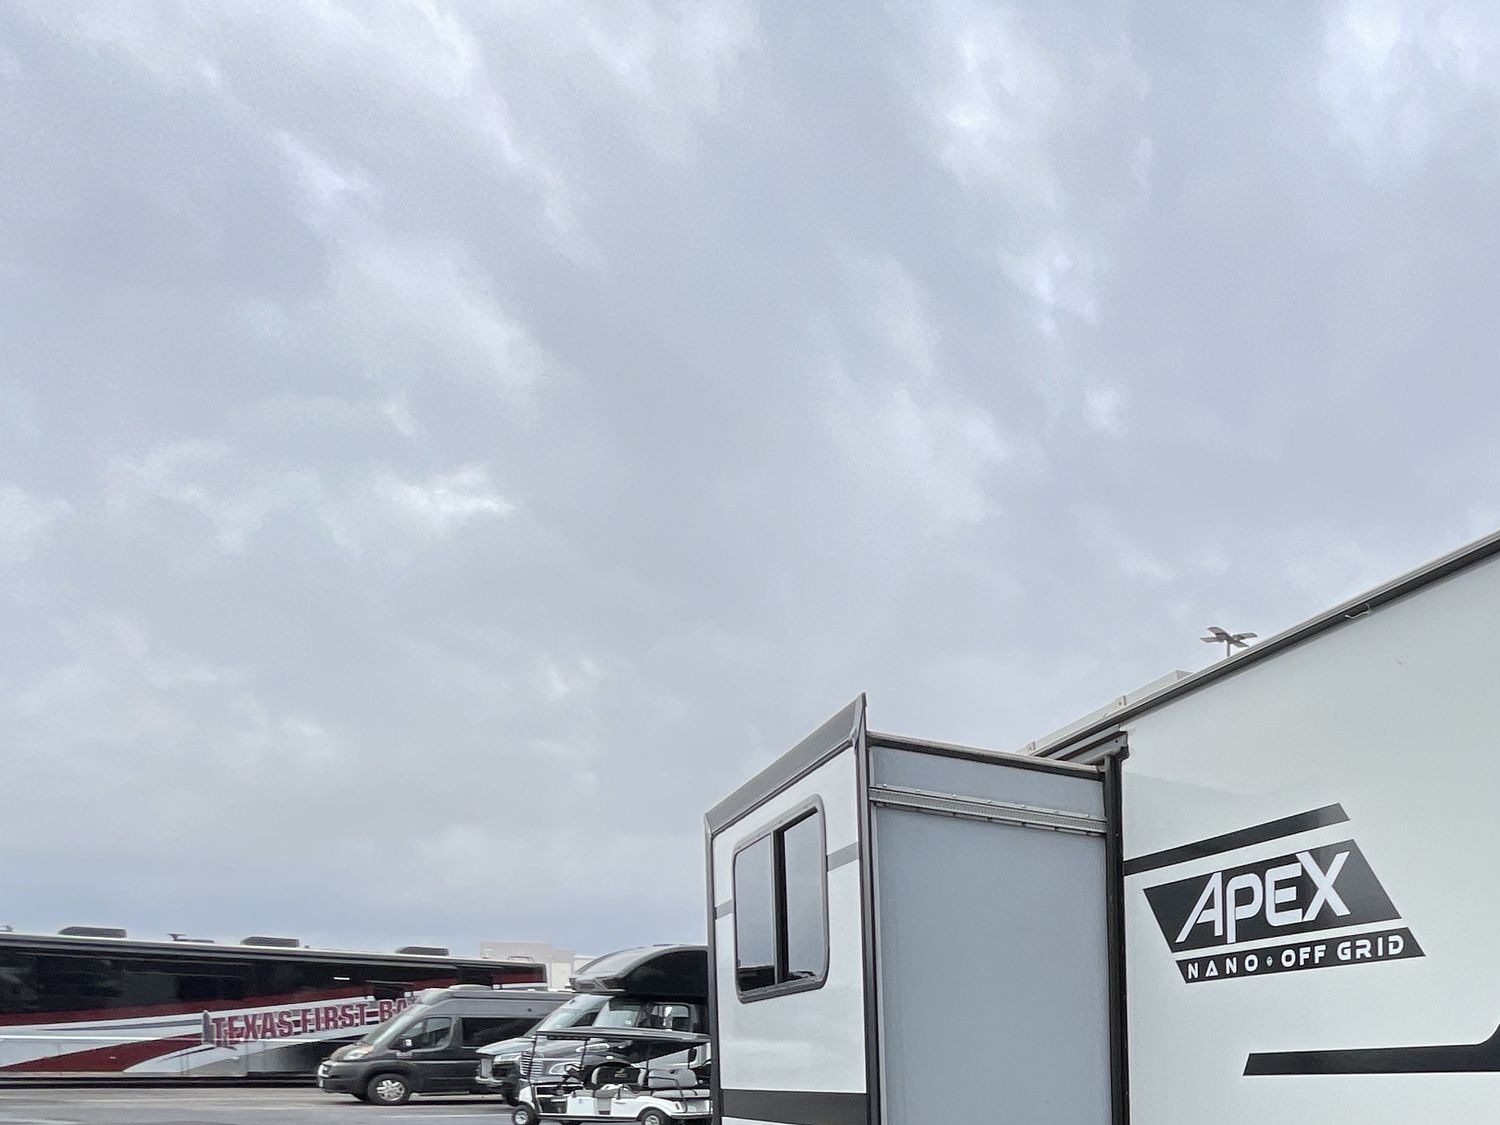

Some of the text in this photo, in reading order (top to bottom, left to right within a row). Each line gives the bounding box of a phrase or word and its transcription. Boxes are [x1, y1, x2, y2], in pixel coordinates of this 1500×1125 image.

[1175, 851, 1350, 943] APEX
[1186, 934, 1405, 980] NANO OFF GRID
[211, 1010, 294, 1044] TEXAS
[301, 1003, 368, 1033] FIRST
